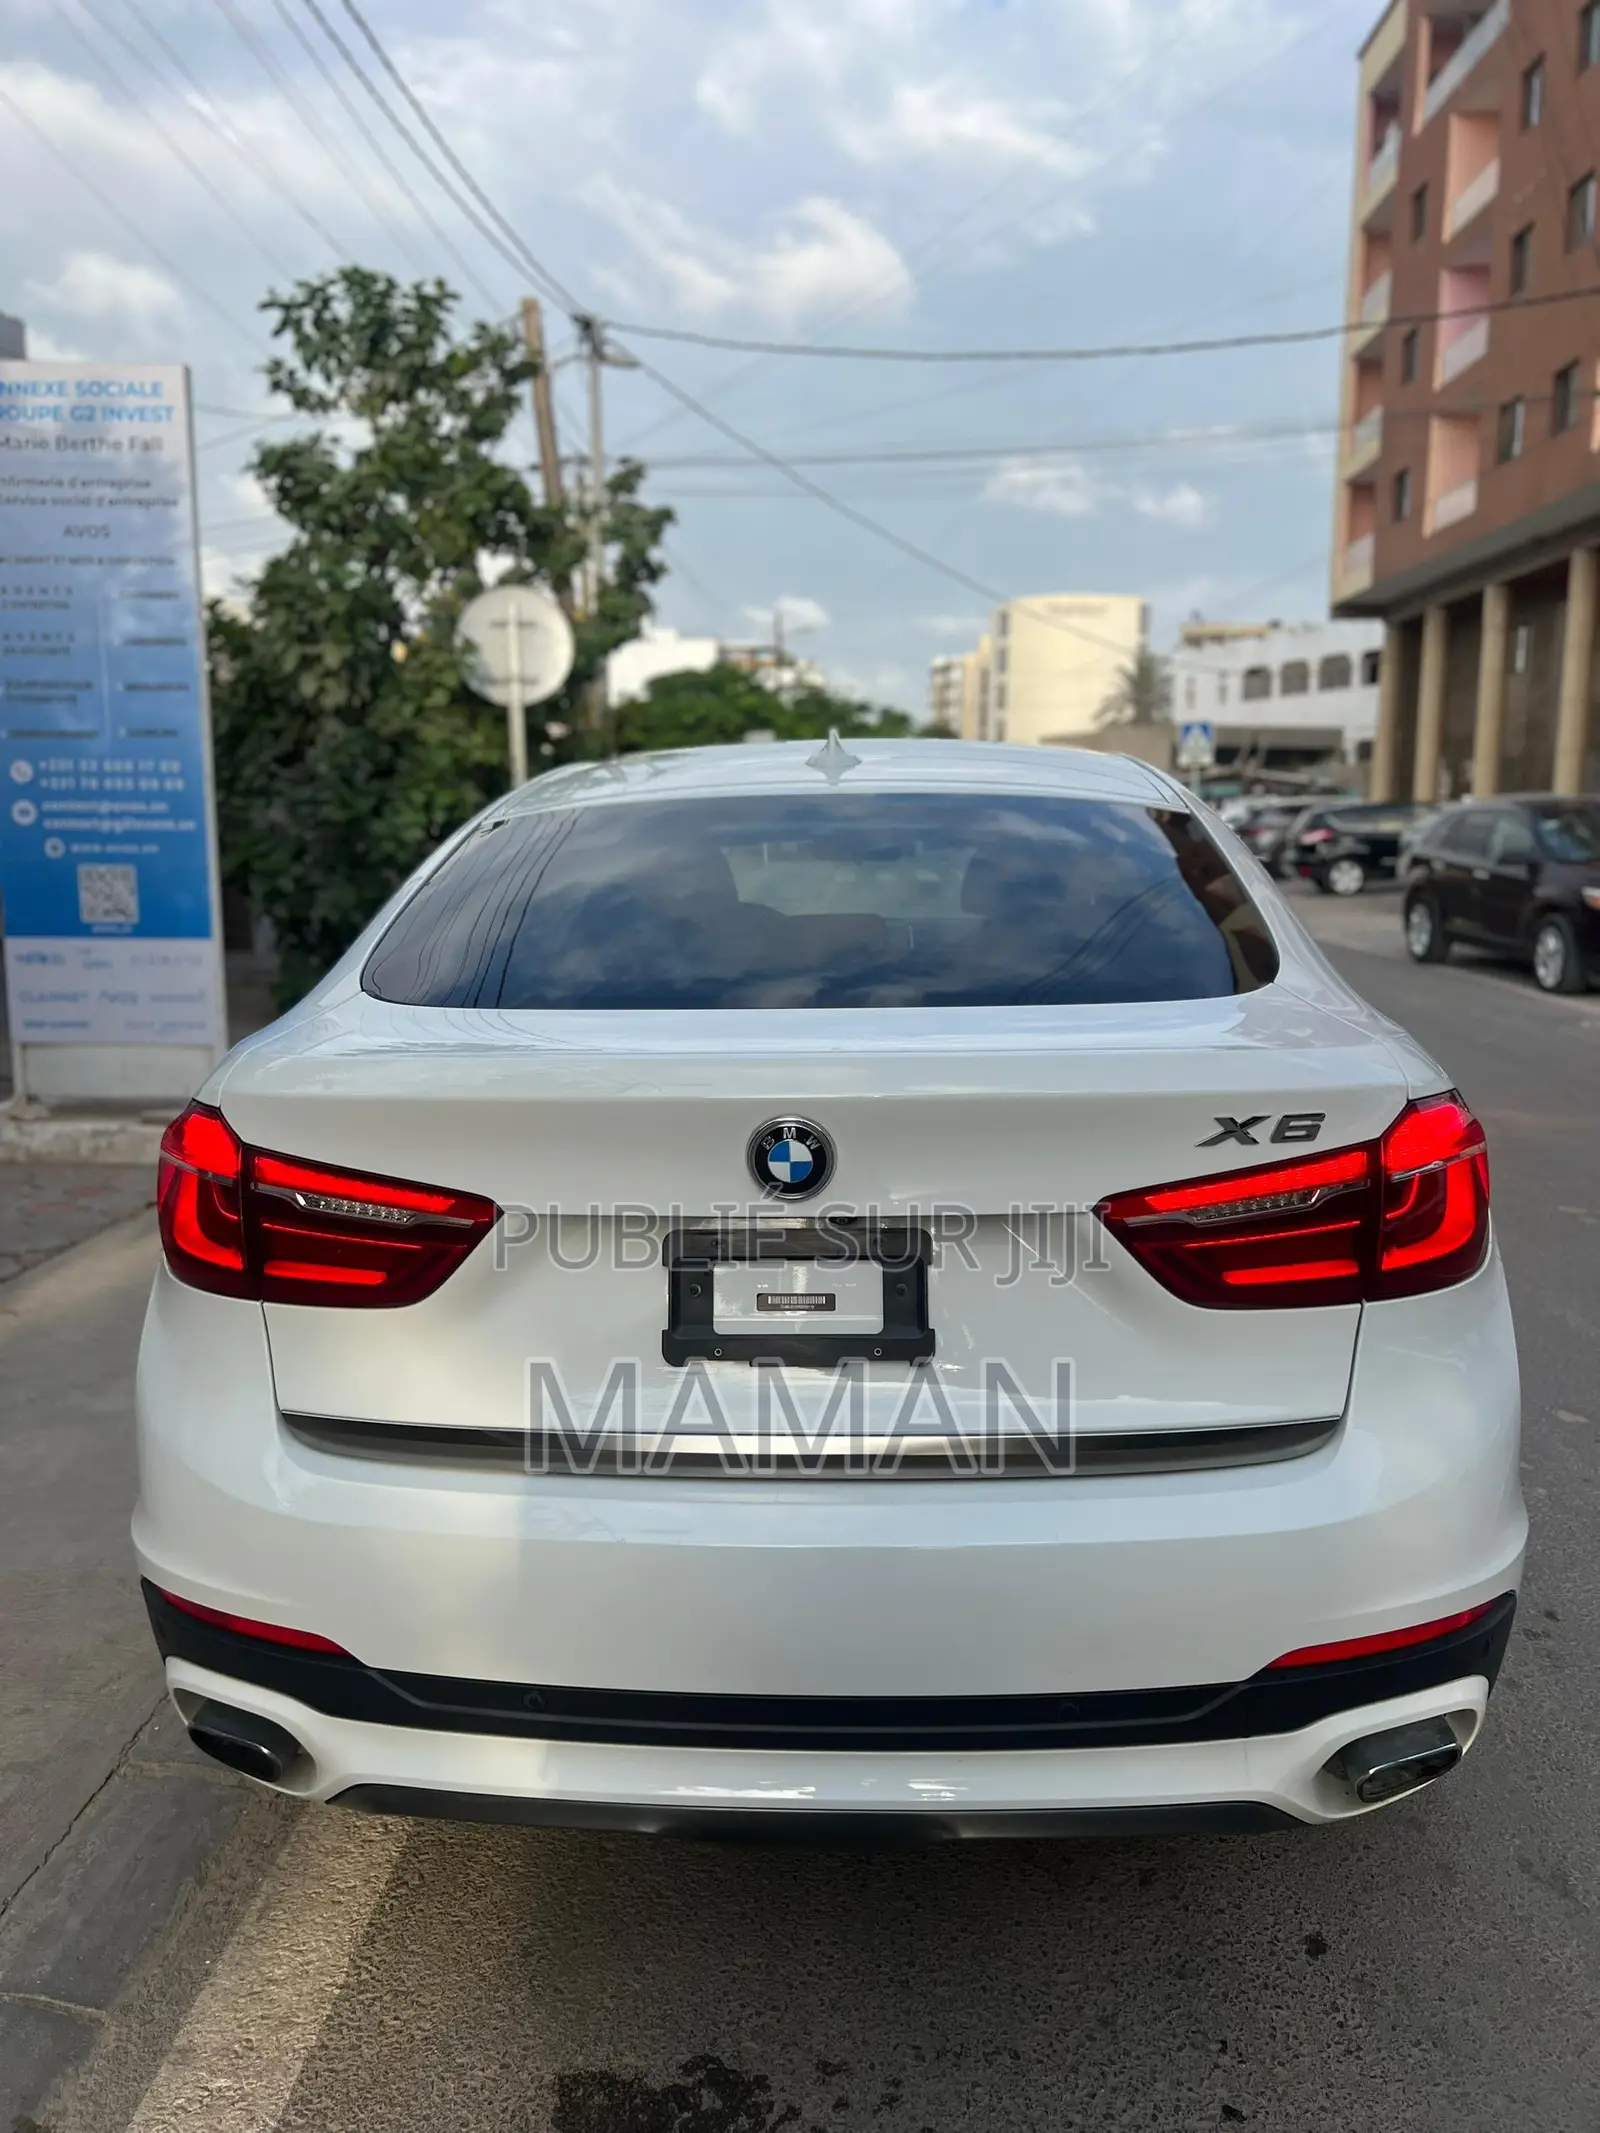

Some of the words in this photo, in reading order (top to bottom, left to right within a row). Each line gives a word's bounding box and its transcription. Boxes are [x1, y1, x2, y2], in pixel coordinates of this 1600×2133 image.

[75, 380, 163, 398] SOCIALE
[101, 405, 174, 423] INVEST
[761, 1127, 820, 1150] BMW
[1194, 1112, 1326, 1147] X6
